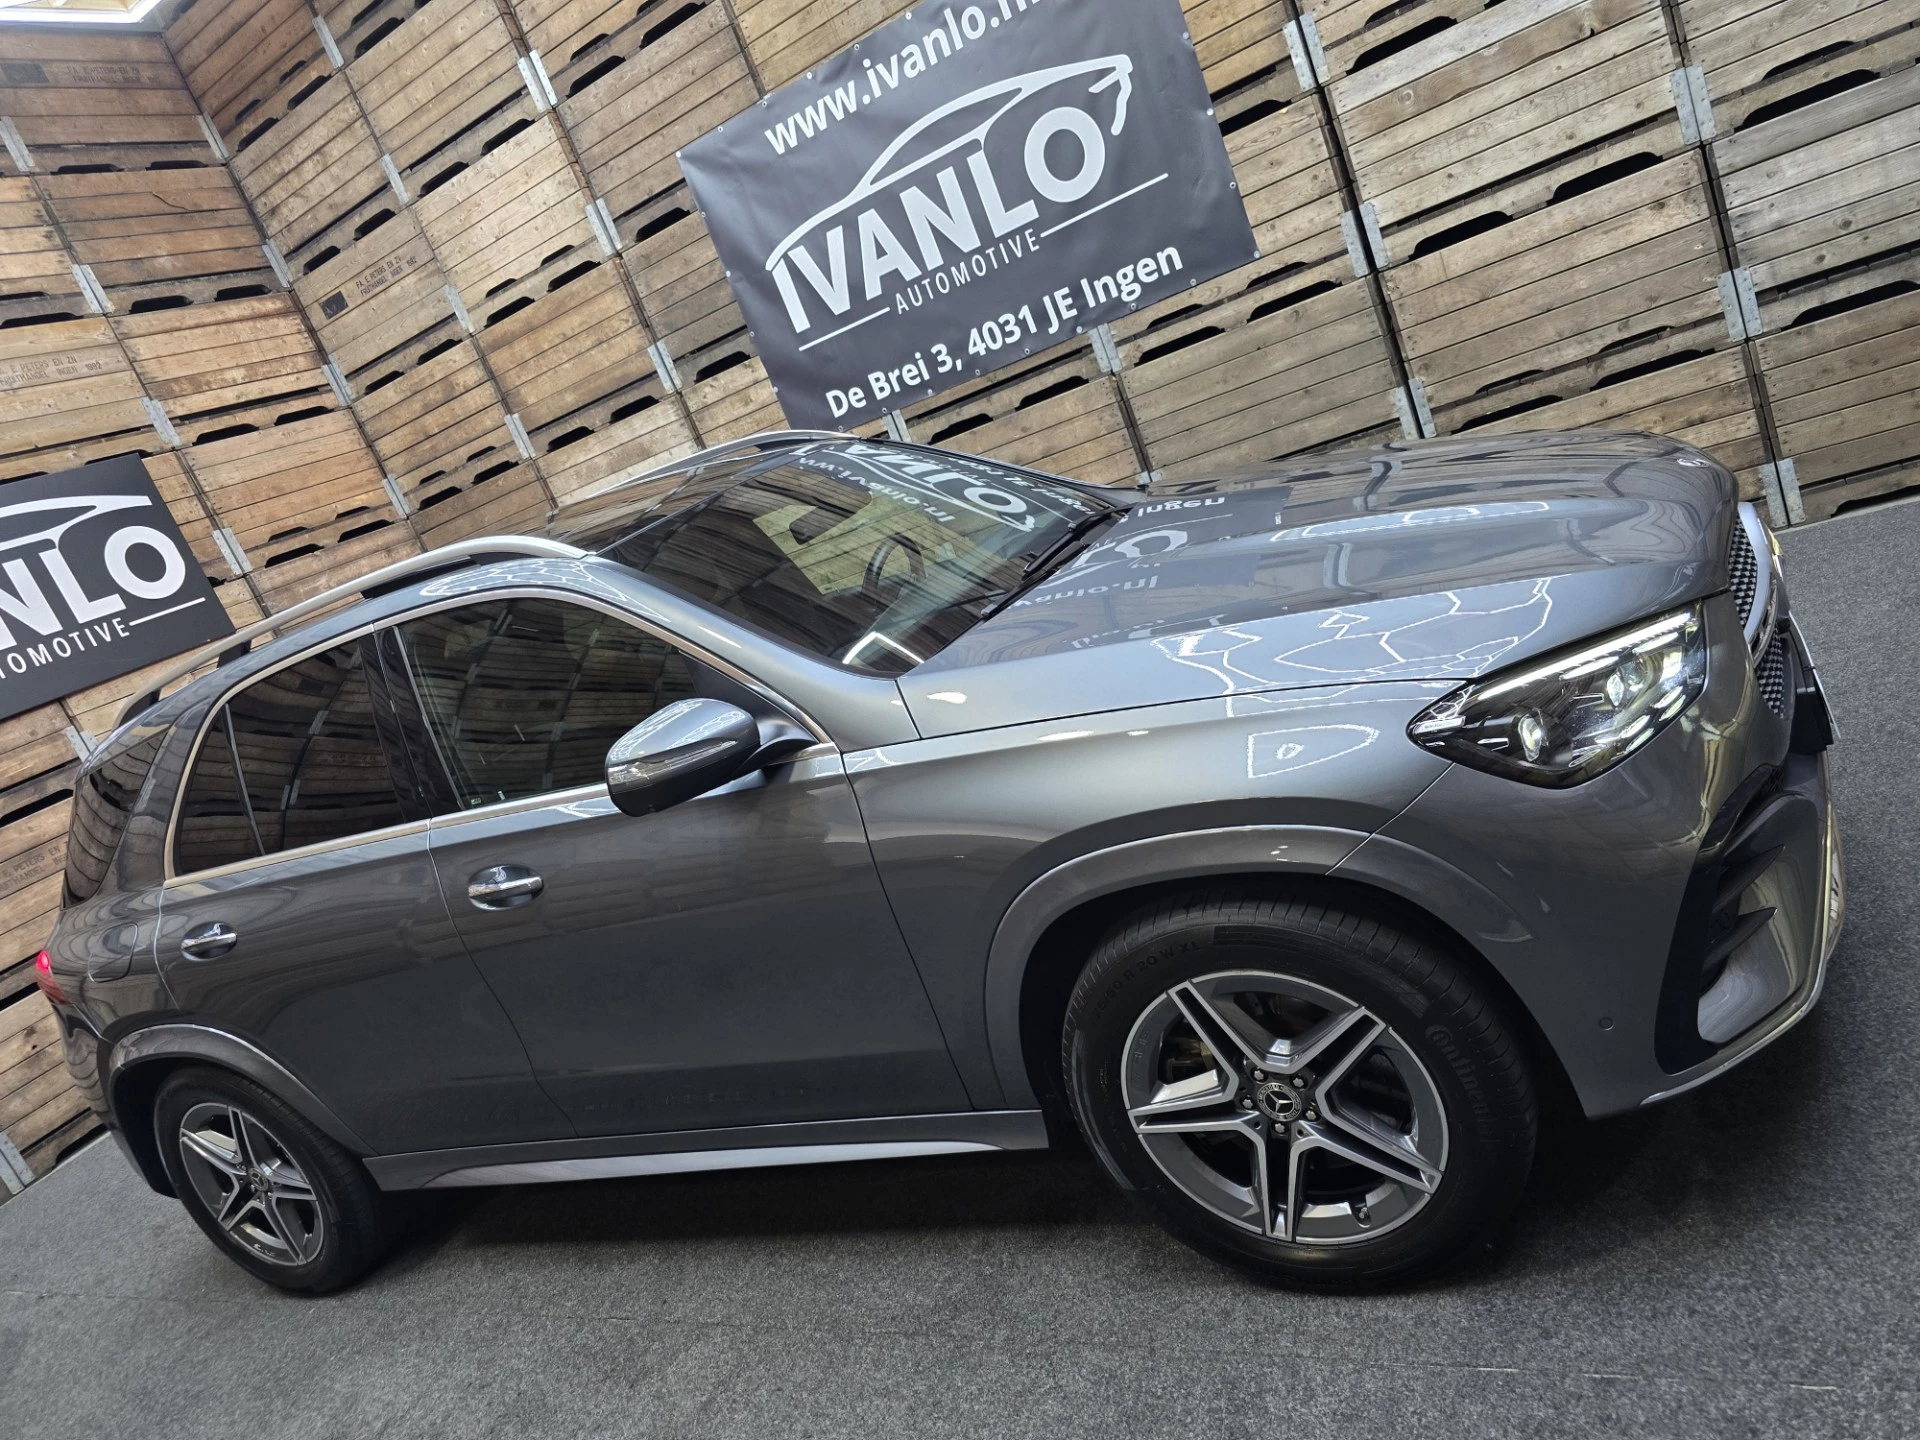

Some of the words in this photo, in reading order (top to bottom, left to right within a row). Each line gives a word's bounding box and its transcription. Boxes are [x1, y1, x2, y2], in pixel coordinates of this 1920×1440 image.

[764, 0, 1041, 155] www.ivanlo.
[772, 107, 1105, 333] IVANLO
[896, 229, 1040, 315] AUTOMOTIVE
[825, 386, 867, 419] De
[867, 352, 930, 401] Brei
[930, 343, 963, 372] 3,
[967, 305, 1038, 358] 4031
[1042, 287, 1077, 335] JE
[1080, 245, 1184, 303] Ingen
[0, 525, 186, 651] NLO
